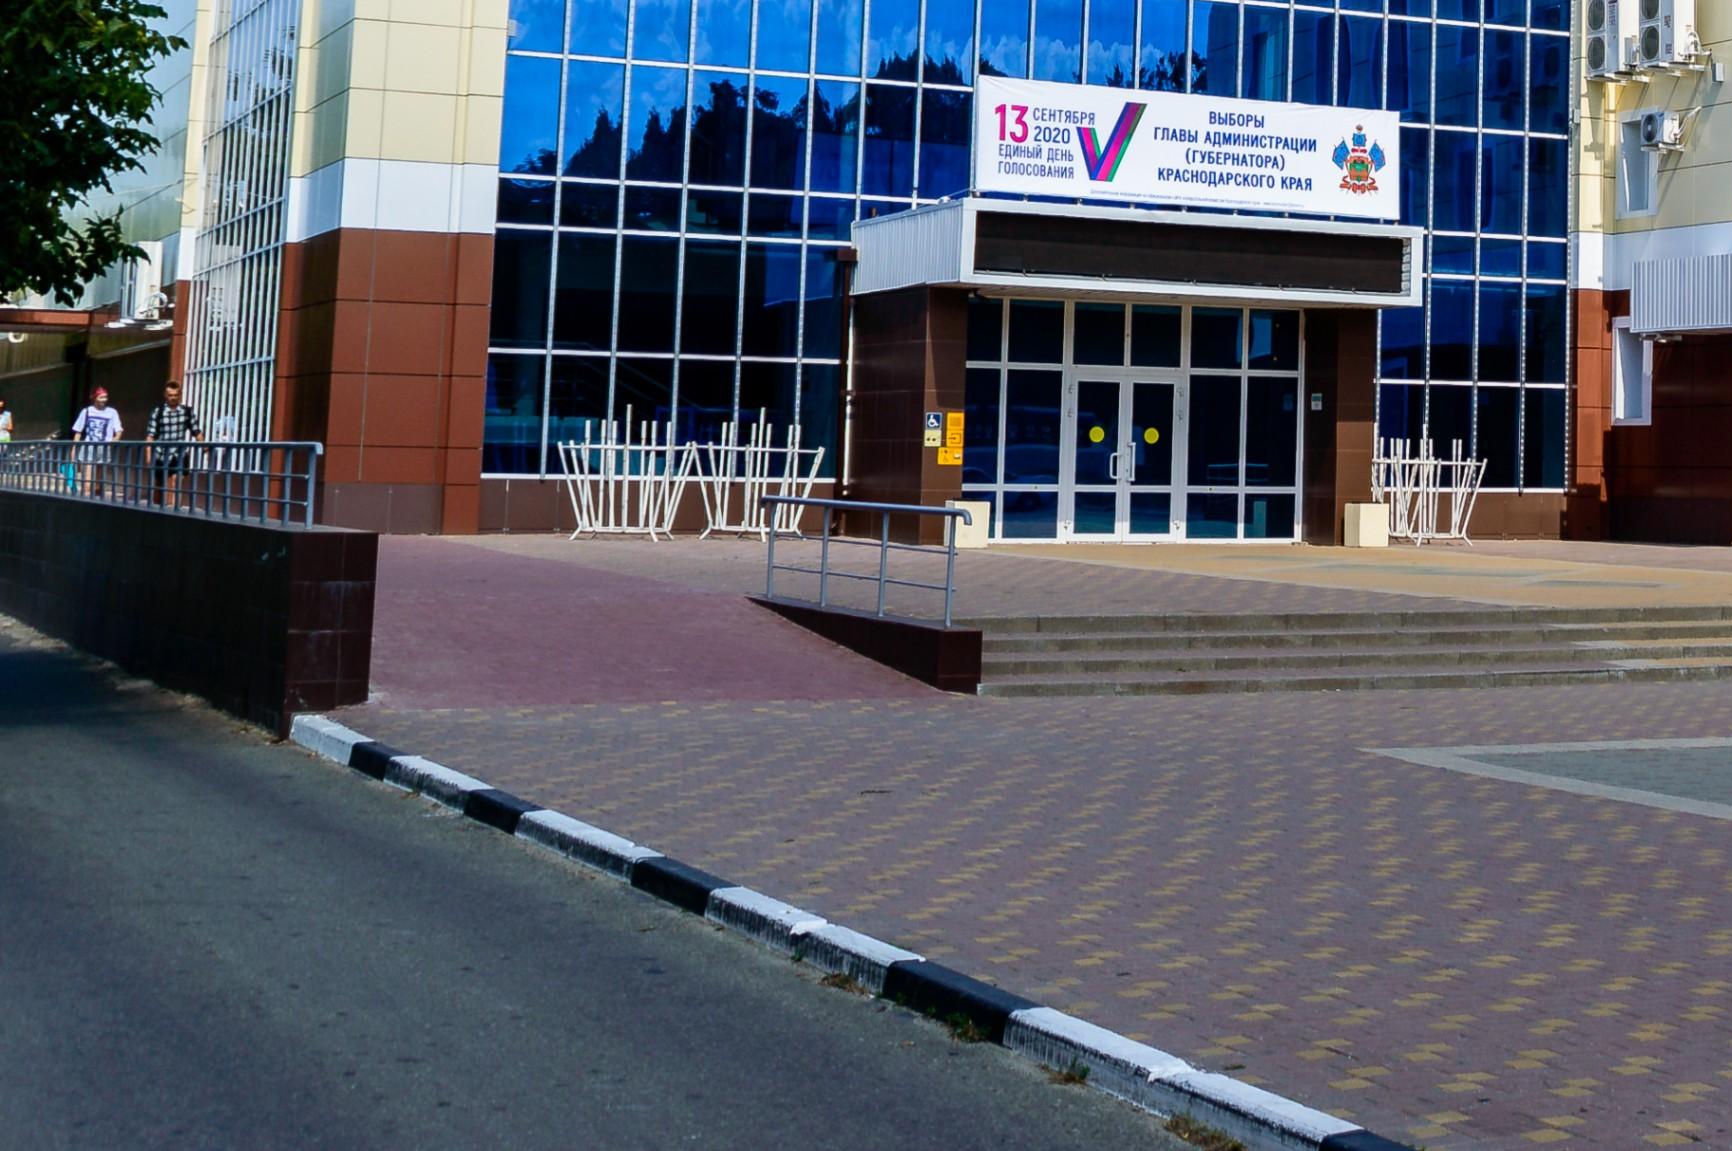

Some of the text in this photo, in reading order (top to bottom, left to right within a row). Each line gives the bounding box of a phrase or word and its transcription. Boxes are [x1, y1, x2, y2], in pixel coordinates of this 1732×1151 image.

[995, 104, 1096, 143] 13 СЕНТЯБРЯ
[1208, 111, 1265, 128] ВЫБОРЫ
[1033, 125, 1071, 144] 2020
[1153, 127, 1318, 154] ГЛАВЫ АДМИНИСТРАЦИИ
[998, 144, 1075, 163] ЕДИНЫЙ ДЕНЬ
[1185, 148, 1286, 171] (ГУБЕРНАТОРА)
[998, 161, 1075, 179] ГОЛОСОВАНИЯ
[1157, 167, 1313, 191] КРАСНОДАРСКОГО КРАЯ
